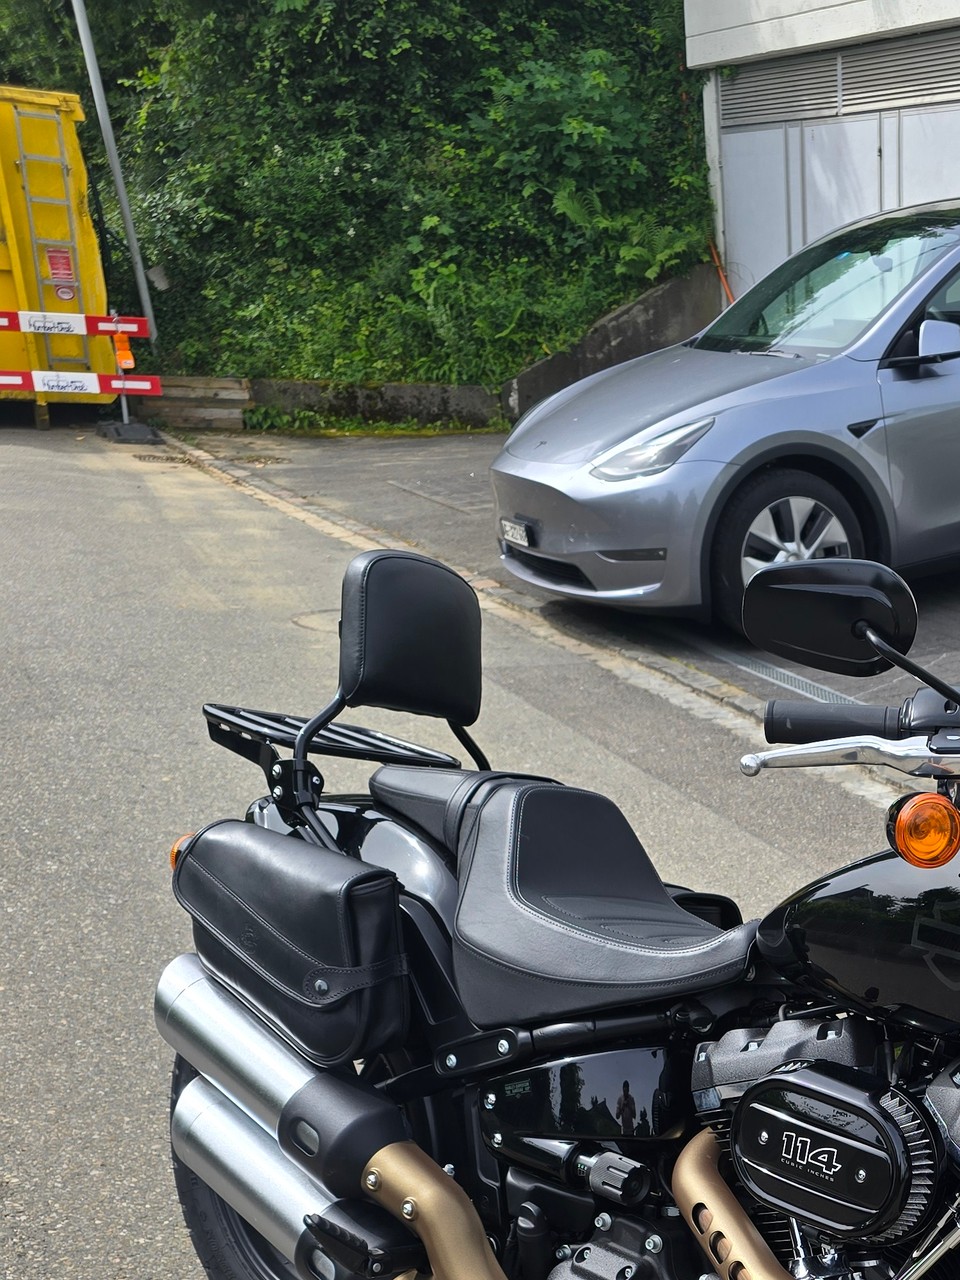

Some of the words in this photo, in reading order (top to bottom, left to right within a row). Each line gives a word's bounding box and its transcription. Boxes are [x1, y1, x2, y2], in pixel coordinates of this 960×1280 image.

[780, 1157, 804, 1170] CUBIC
[807, 1168, 835, 1182] INCHES
[781, 1131, 842, 1175] 114
